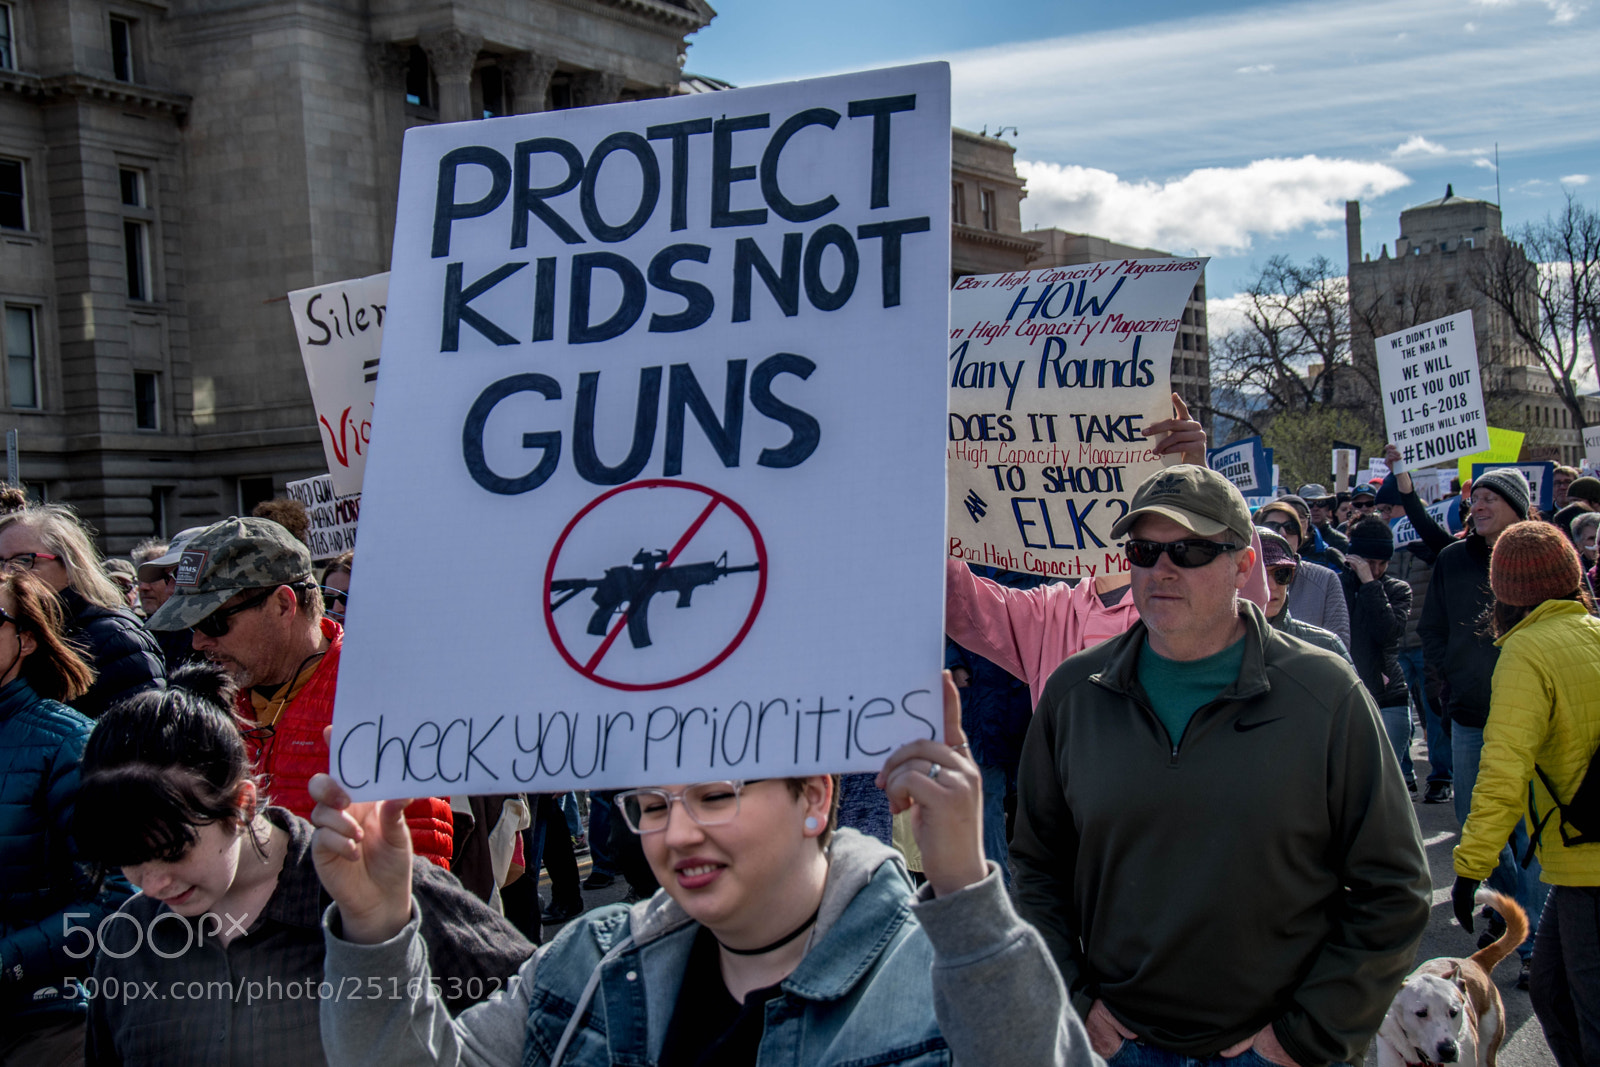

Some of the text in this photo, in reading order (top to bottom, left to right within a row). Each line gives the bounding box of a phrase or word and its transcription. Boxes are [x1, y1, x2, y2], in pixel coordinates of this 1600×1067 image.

[431, 94, 916, 259] PROTECT
[440, 216, 930, 352] KIDS NOT
[954, 259, 1200, 291] Ban High Capacity Magazines
[1006, 276, 1127, 320] HOW
[967, 320, 1010, 345] High
[1015, 316, 1100, 346] Capacity
[1100, 313, 1181, 343] Magazines
[1390, 320, 1456, 349] WE DIDN'T VOTE
[1038, 334, 1155, 389] Rounds
[1401, 336, 1448, 360] THE NRA IN
[1402, 354, 1453, 381] WE WILL
[1389, 369, 1471, 406] VOTE YOU OUT
[462, 352, 821, 496] GUNS
[1393, 409, 1481, 441] THE YOUTH WILL VOTE
[1401, 392, 1468, 424] 11-6-2018
[949, 412, 1148, 443] DOES IT TAKE
[955, 440, 988, 469] High
[997, 441, 1071, 474] Capacity
[1403, 427, 1478, 465] #ENOUGH
[987, 464, 1127, 493] TO SHOOT
[963, 488, 1130, 550] AN ELK?
[949, 537, 981, 559] Ban
[983, 542, 1019, 571] High
[1023, 551, 1097, 579] Capacity
[337, 713, 505, 790] check
[511, 710, 635, 784] your
